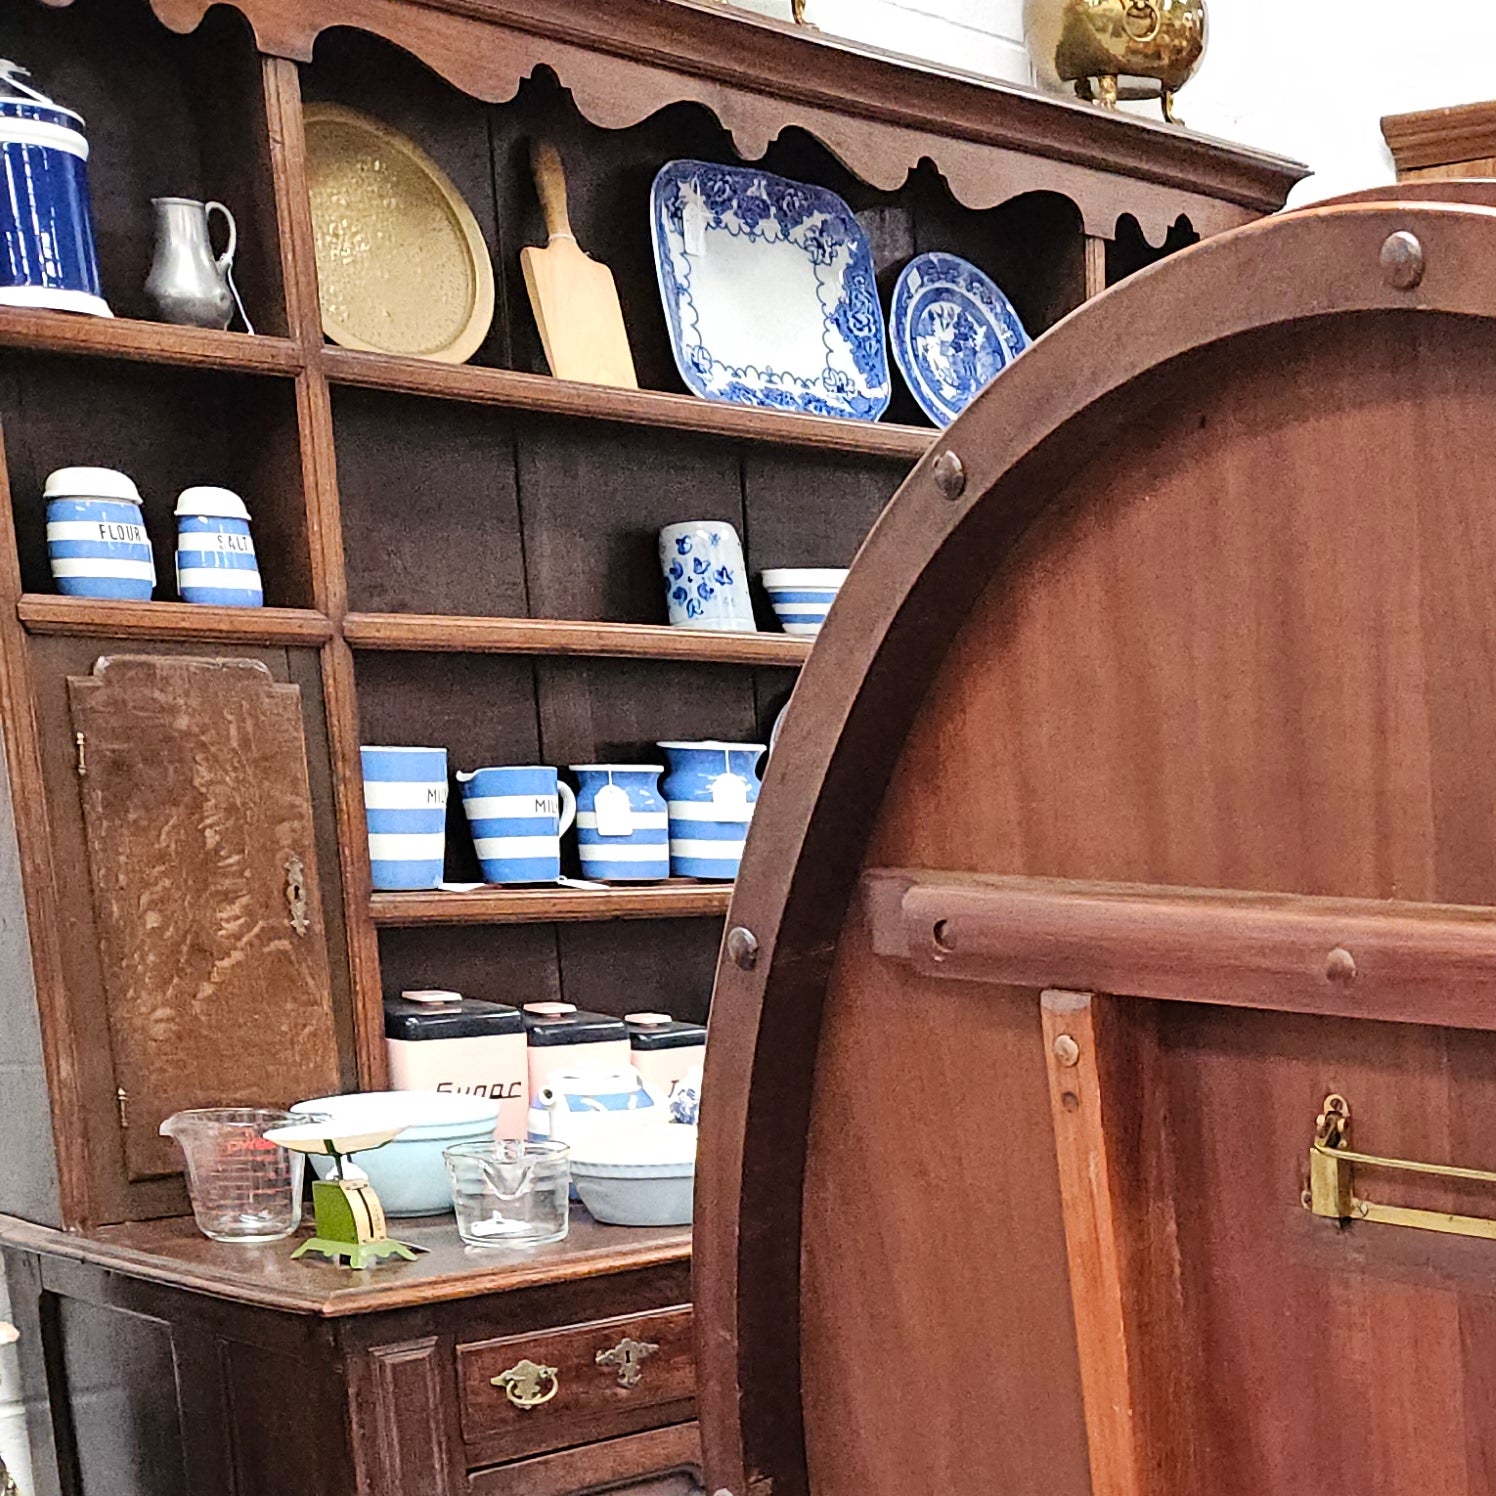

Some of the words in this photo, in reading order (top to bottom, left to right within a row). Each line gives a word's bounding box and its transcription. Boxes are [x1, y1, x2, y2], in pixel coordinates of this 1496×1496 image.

[99, 523, 142, 542] FLOUR
[216, 534, 249, 552] SALT
[427, 787, 448, 804] MIL
[534, 798, 558, 814] MIL
